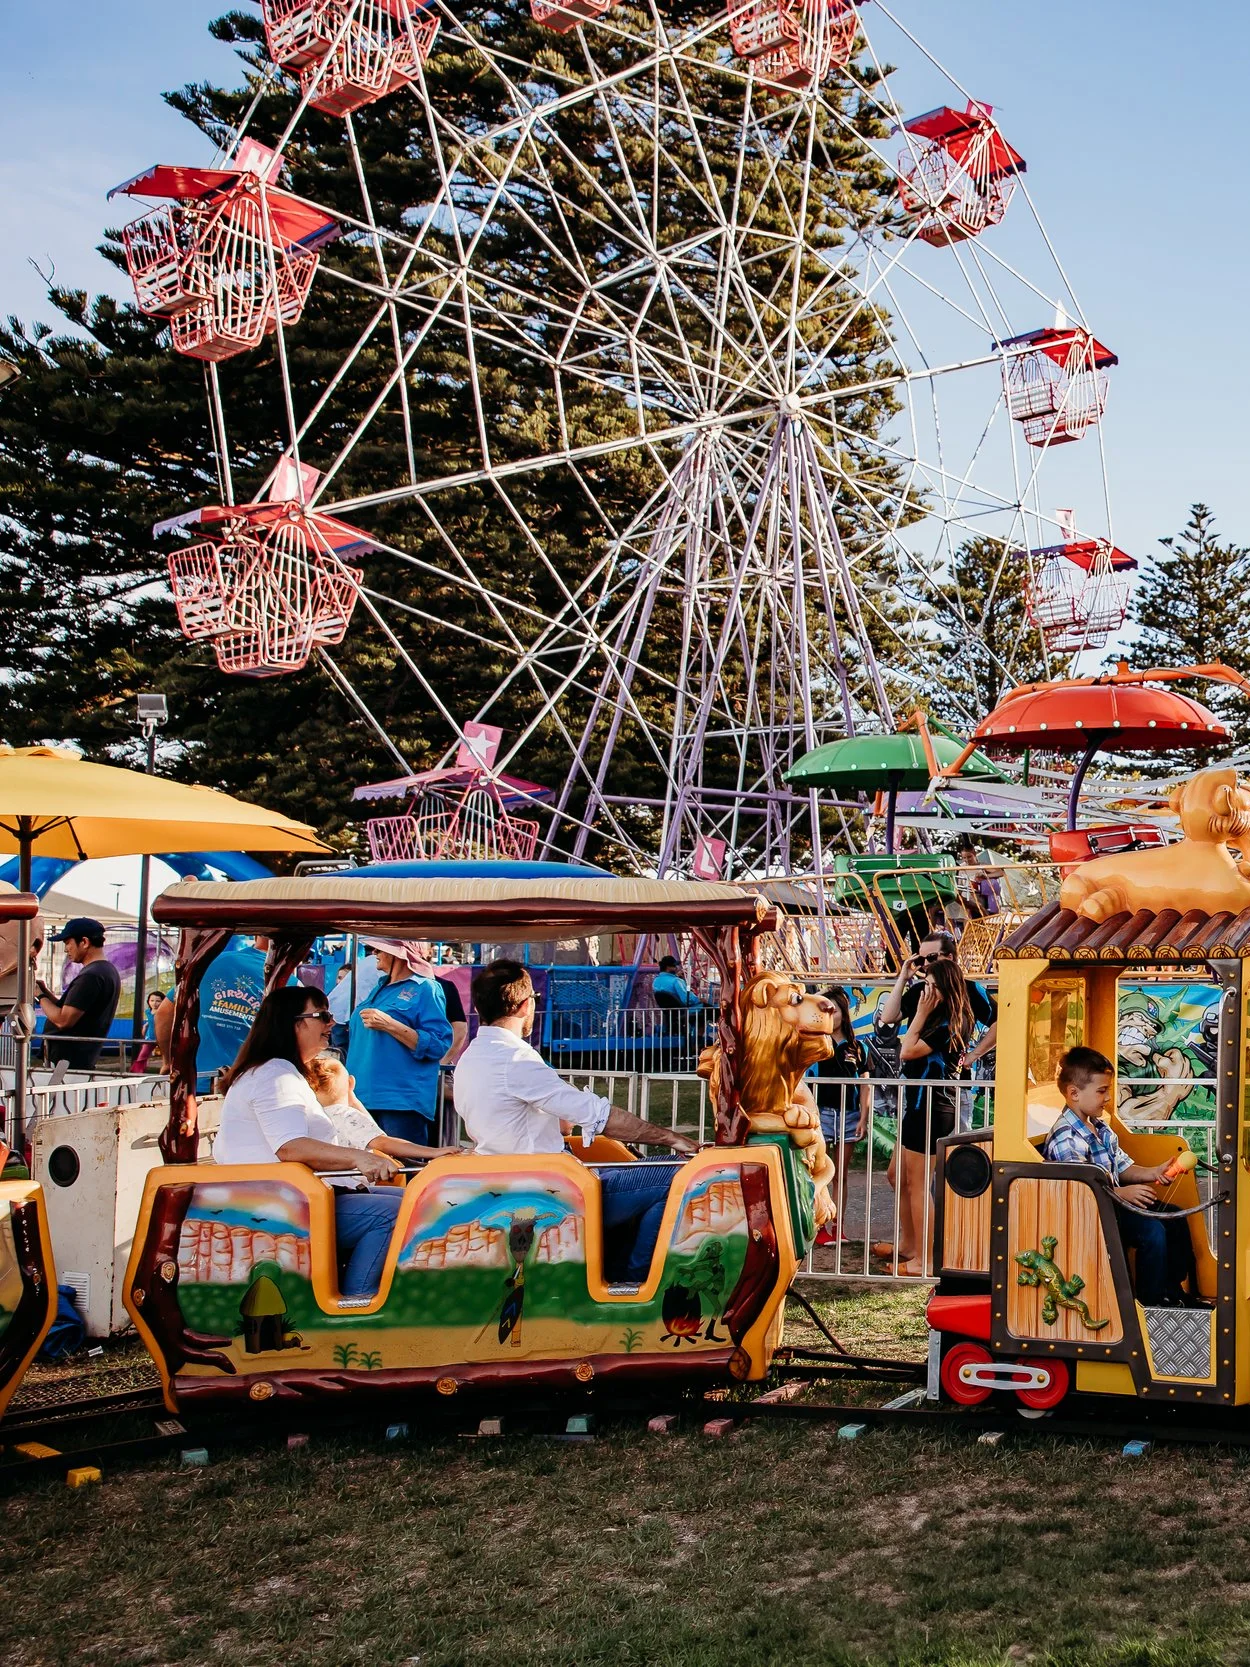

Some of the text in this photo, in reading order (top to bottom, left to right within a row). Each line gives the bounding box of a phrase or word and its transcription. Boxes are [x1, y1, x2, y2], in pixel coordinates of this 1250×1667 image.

[700, 841, 716, 875] L
[209, 1006, 257, 1021] AMUSEMENTS
[217, 1000, 251, 1014] FAMILY
